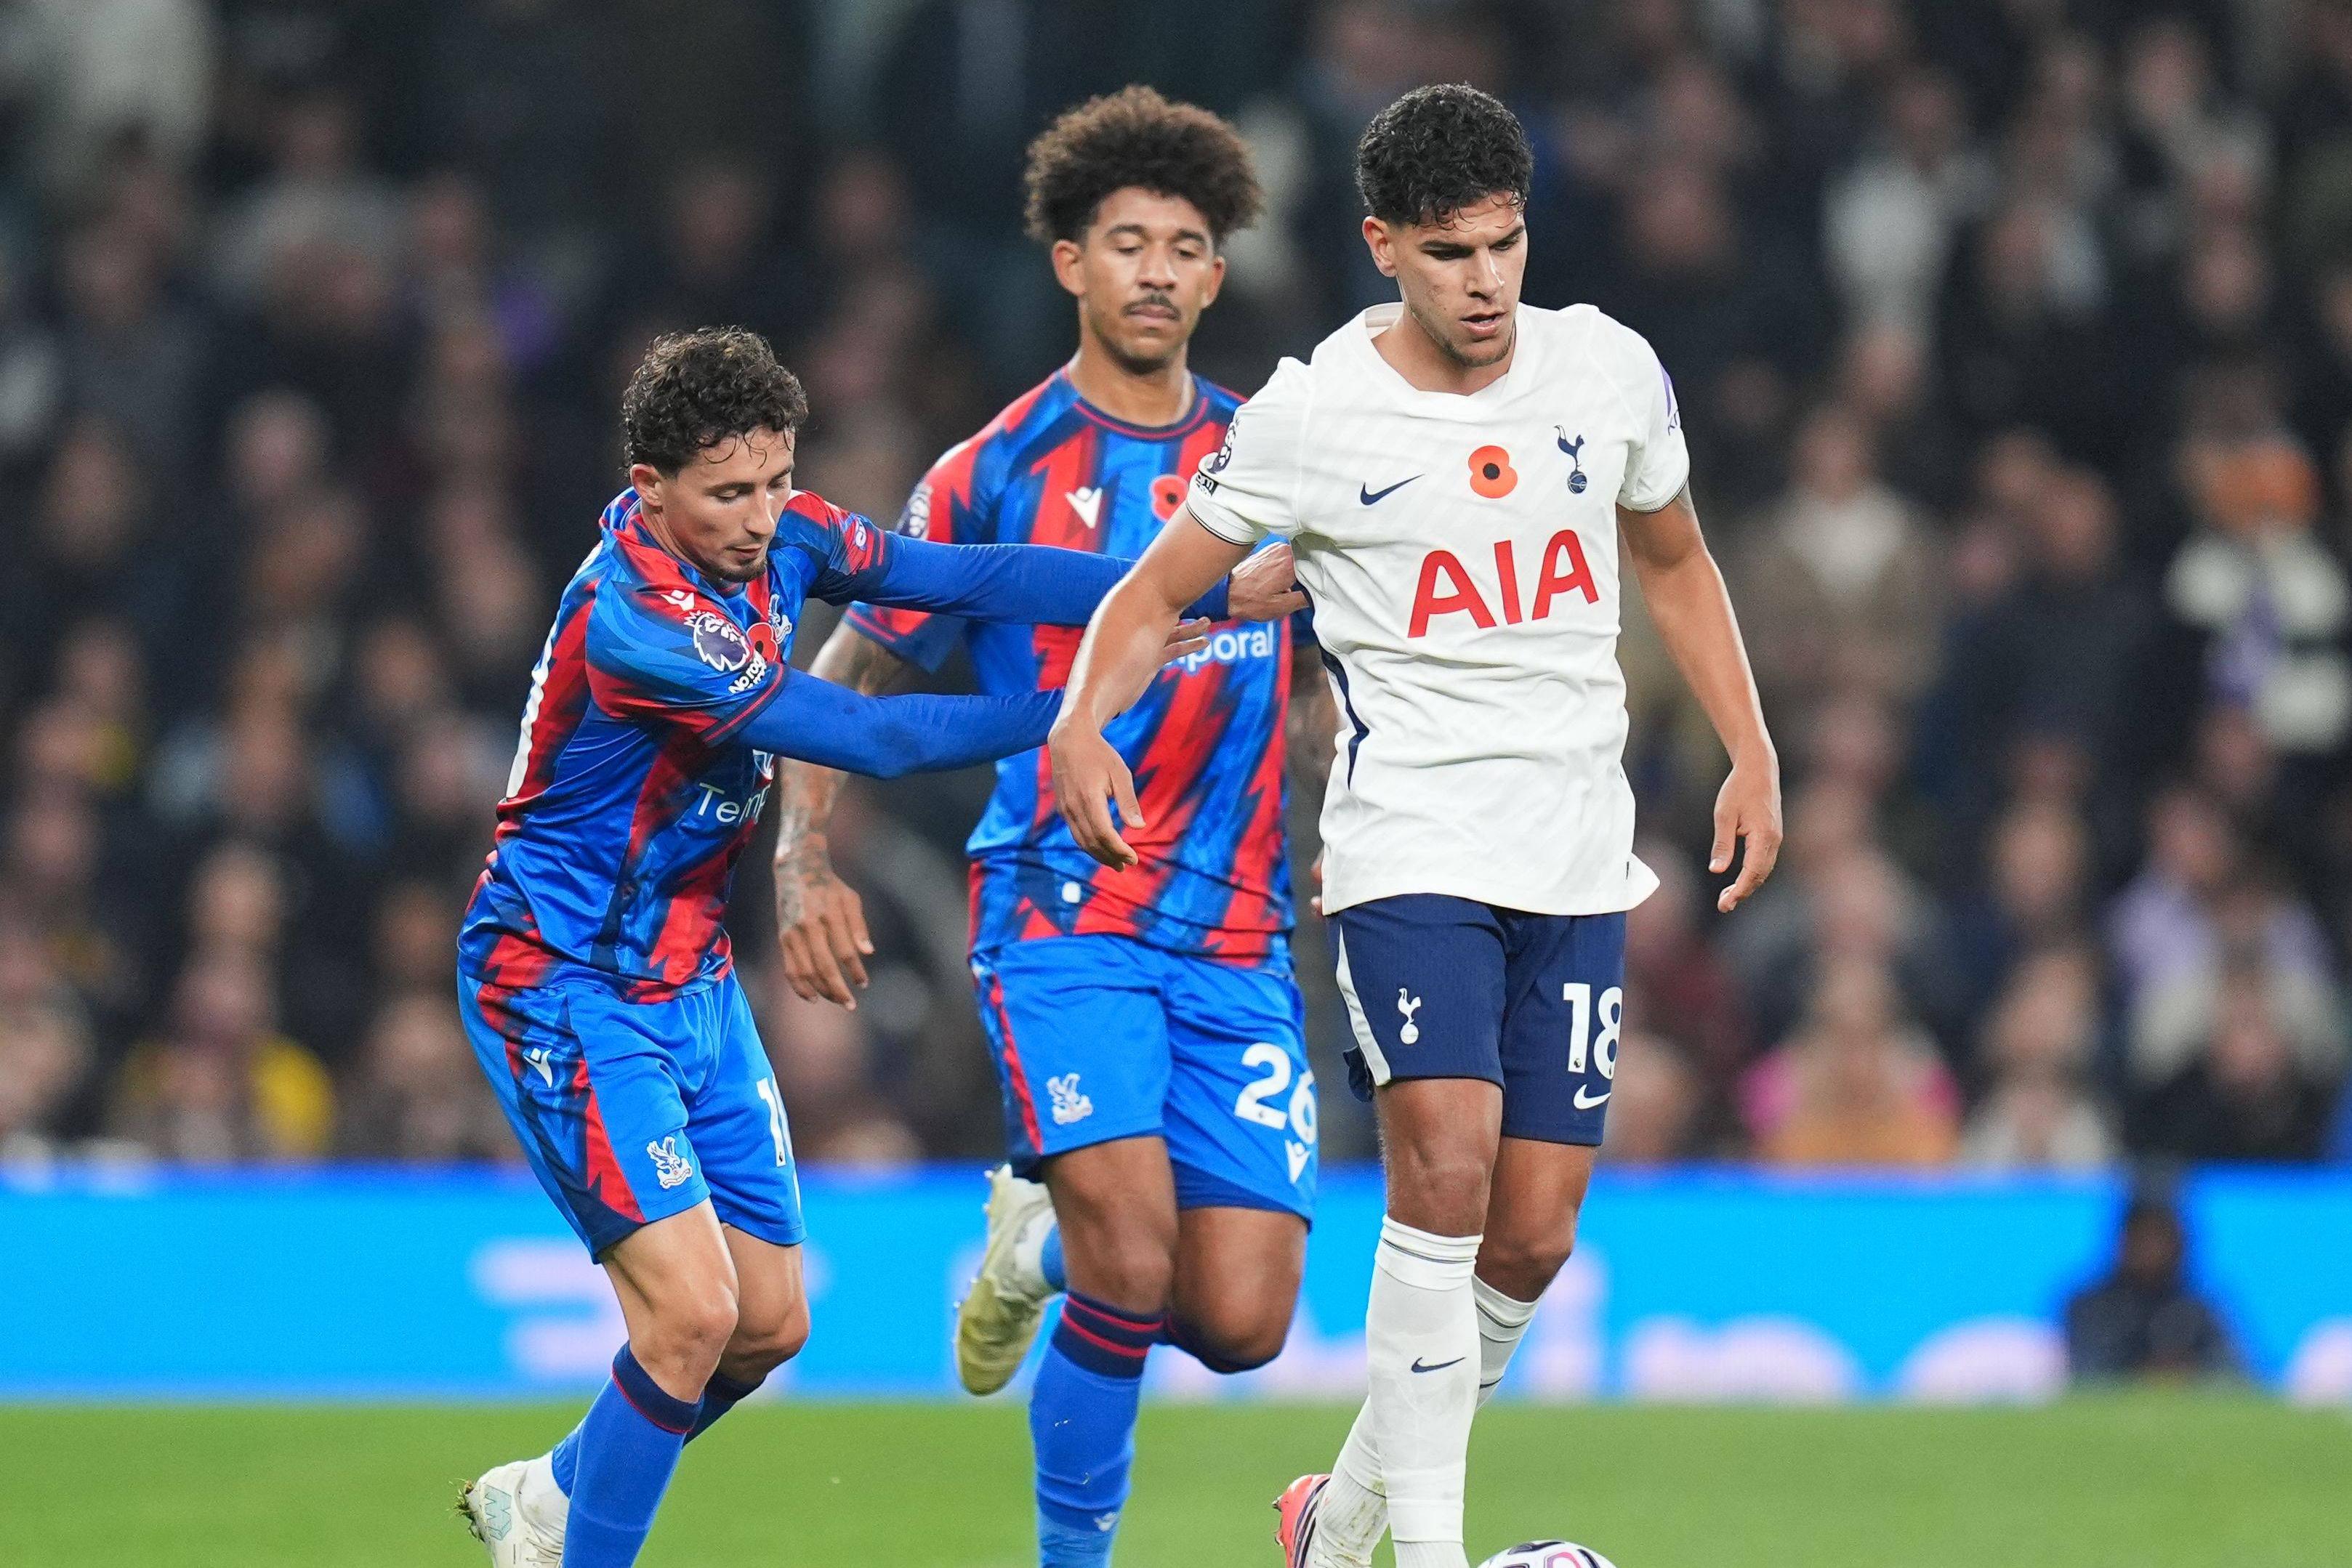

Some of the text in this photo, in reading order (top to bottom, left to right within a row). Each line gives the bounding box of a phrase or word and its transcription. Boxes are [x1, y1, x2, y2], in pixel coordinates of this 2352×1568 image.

[1407, 529, 1599, 638] AIA
[728, 676, 749, 694] No
[1164, 621, 1274, 672] poral
[1563, 982, 1623, 1080] 18
[1234, 1042, 1319, 1145] 26
